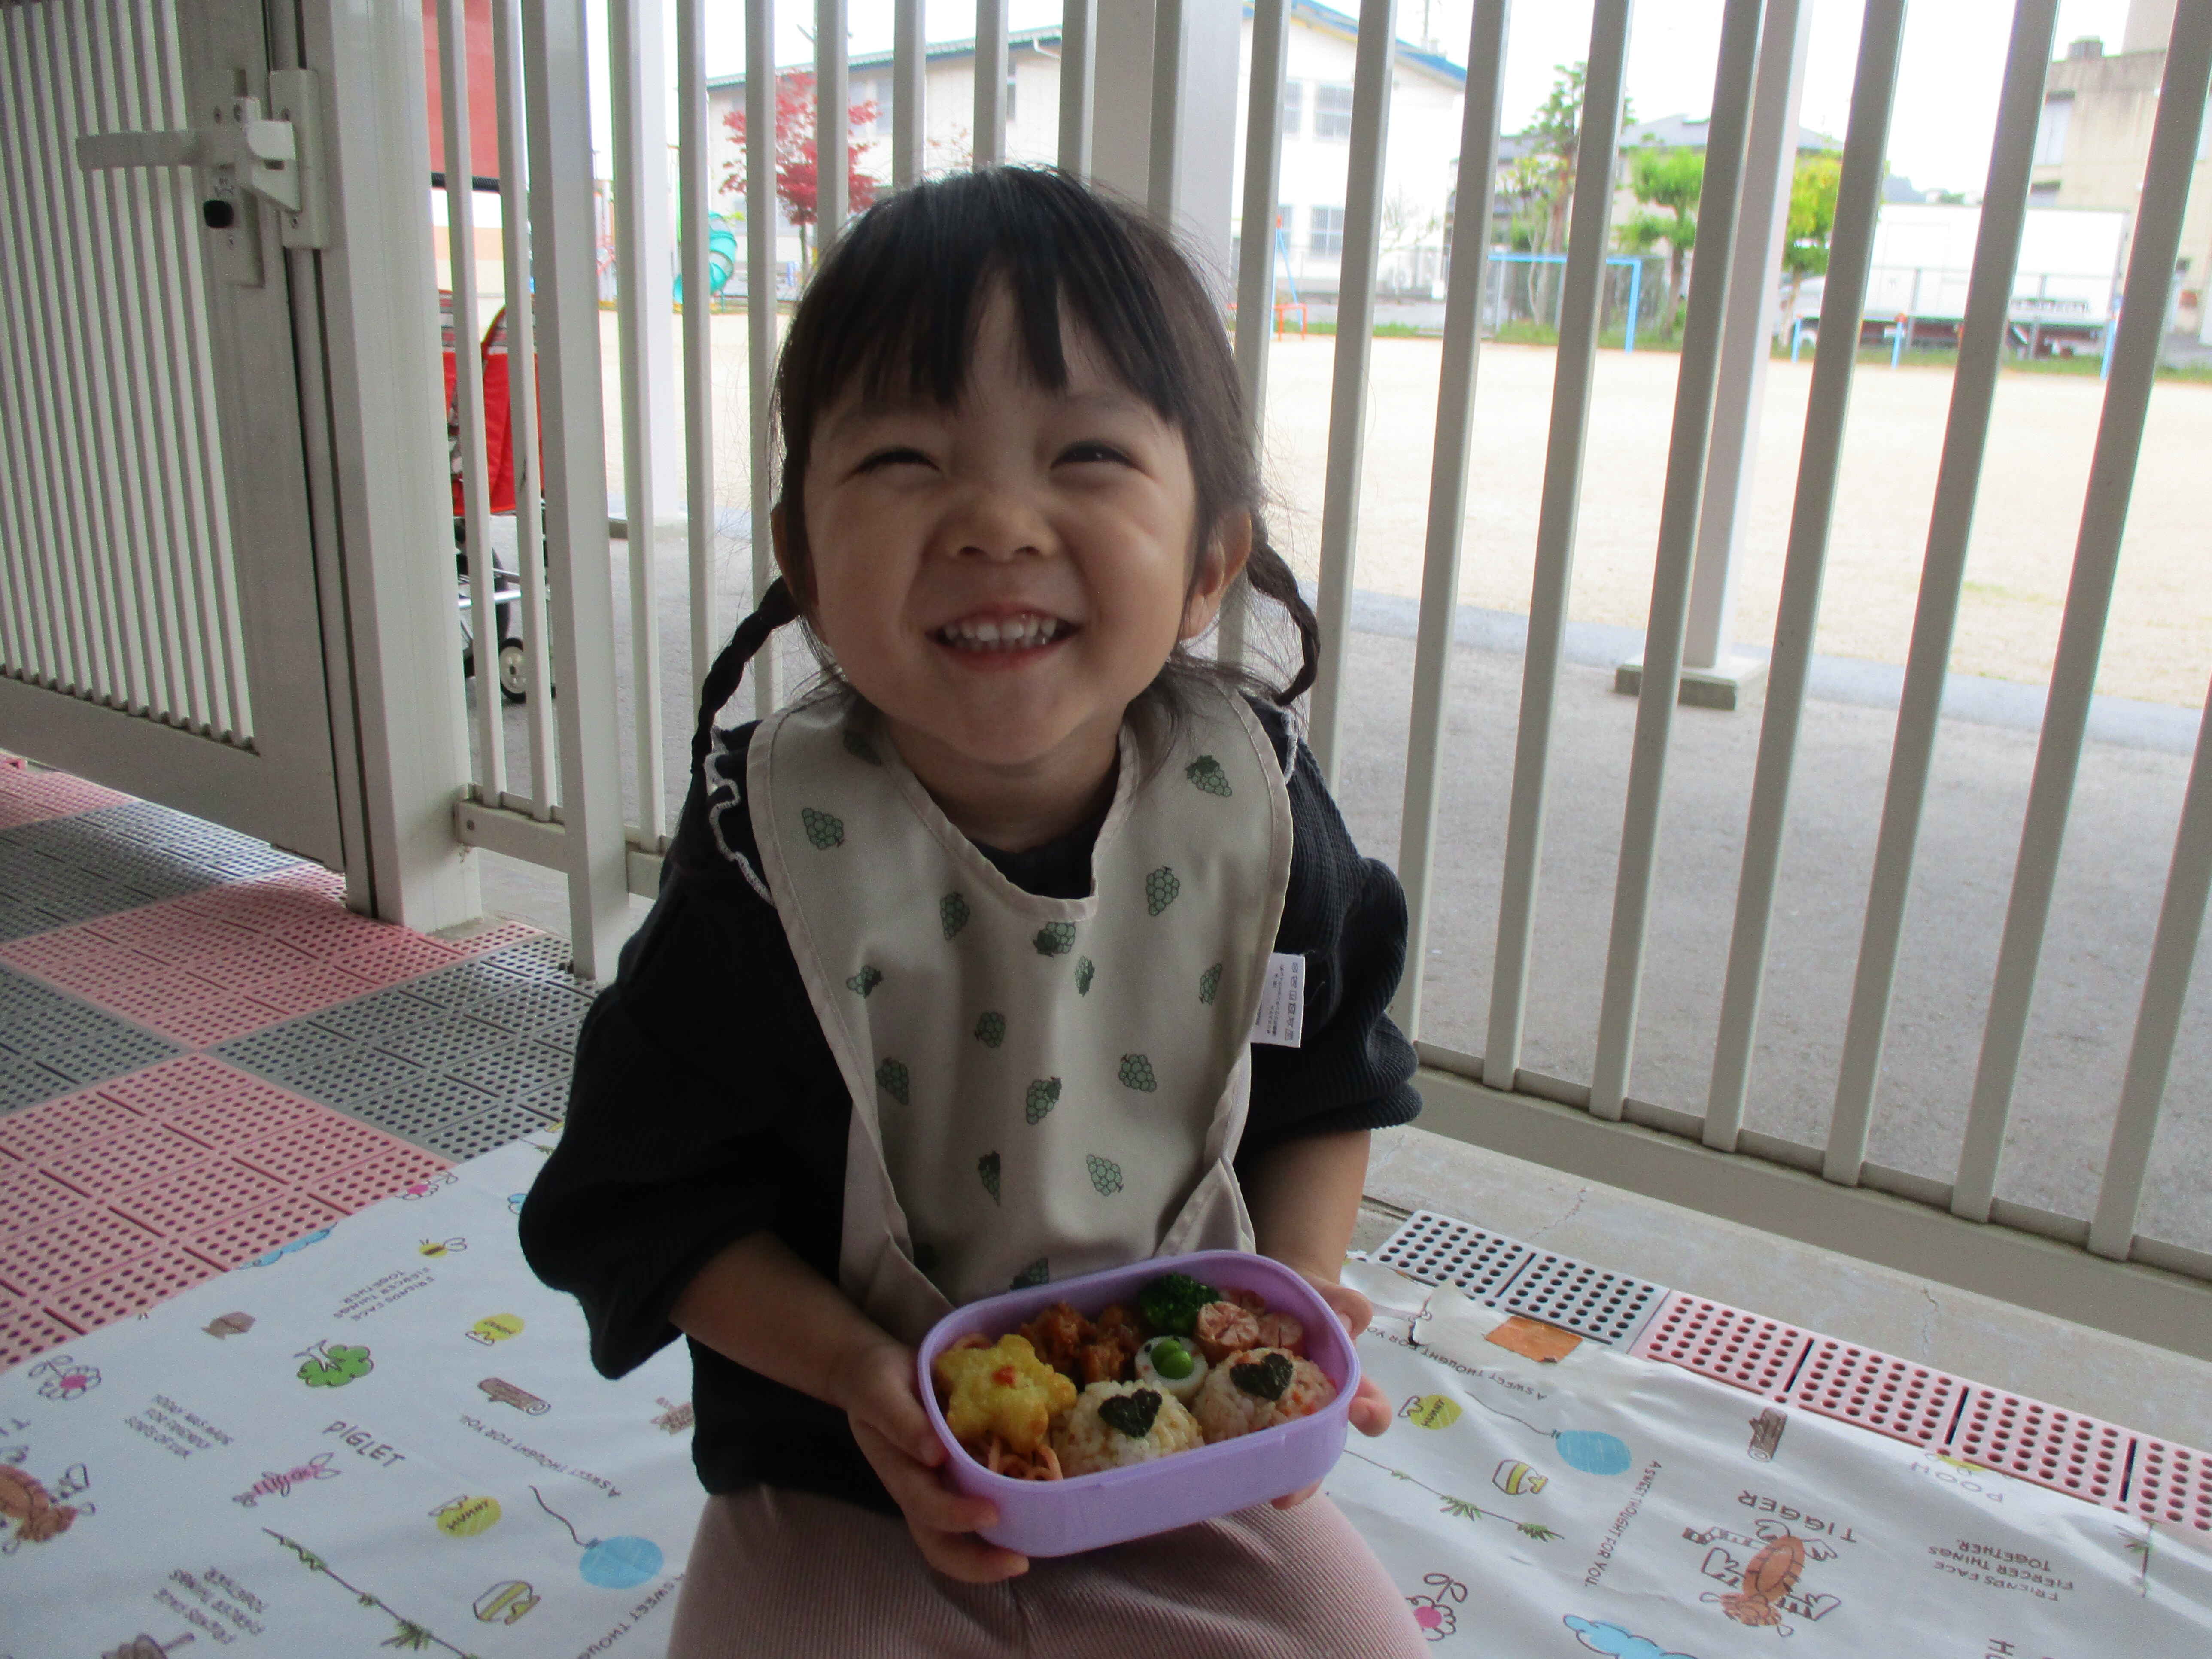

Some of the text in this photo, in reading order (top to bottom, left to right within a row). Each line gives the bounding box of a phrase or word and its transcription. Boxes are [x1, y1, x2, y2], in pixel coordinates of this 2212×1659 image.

[1367, 1326, 1384, 1338] YO
[1421, 1347, 1483, 1377] THOUGHT
[1488, 1373, 1536, 1395] SWEET
[1536, 1392, 1548, 1401] A
[322, 1421, 406, 1467] PIGLET
[1636, 1468, 1657, 1497] SWEET
[1608, 1497, 1642, 1539] THOUGHT
[1737, 1490, 1857, 1543] TIGGER
[1598, 1537, 1616, 1559] FOR
[1929, 1546, 2074, 1591] FIERCER THINGS
[1934, 1562, 2058, 1601] FRIENDS FACE
